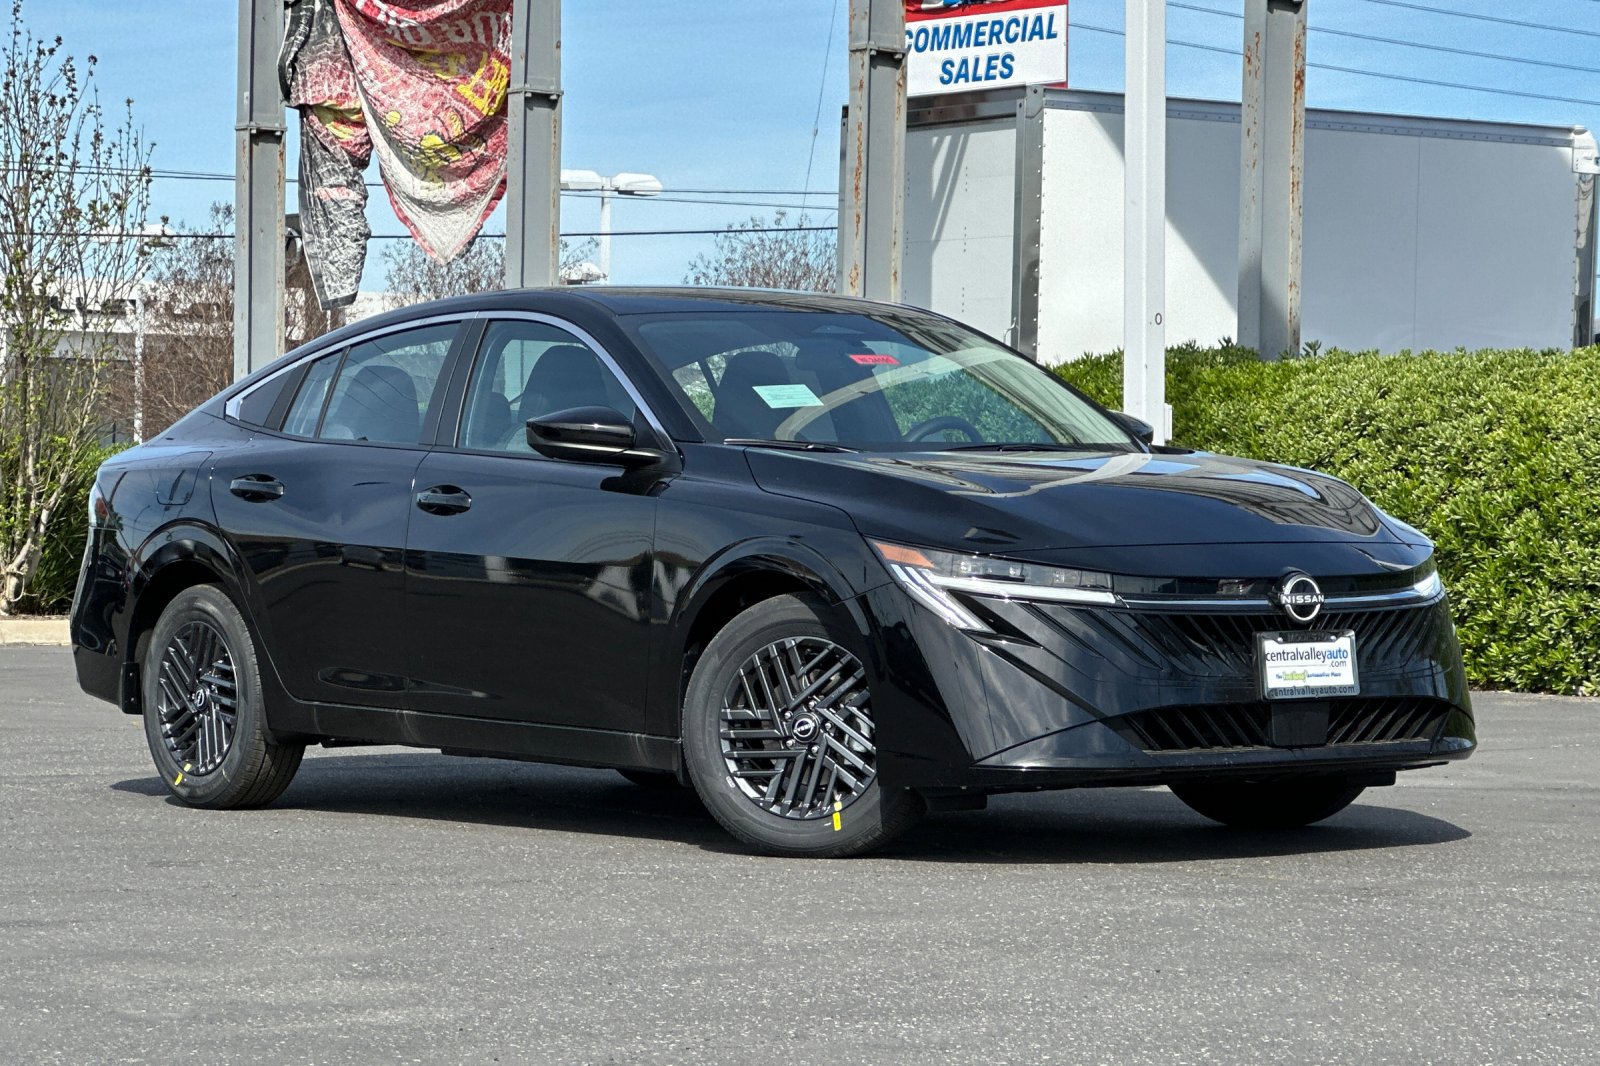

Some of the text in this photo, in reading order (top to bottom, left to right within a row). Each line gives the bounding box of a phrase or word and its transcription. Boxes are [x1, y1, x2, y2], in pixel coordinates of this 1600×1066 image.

[939, 52, 1015, 86] SALES
[1283, 595, 1325, 604] NISSAN
[1266, 647, 1348, 663] centralvalleyauto
[1329, 659, 1347, 668] .com
